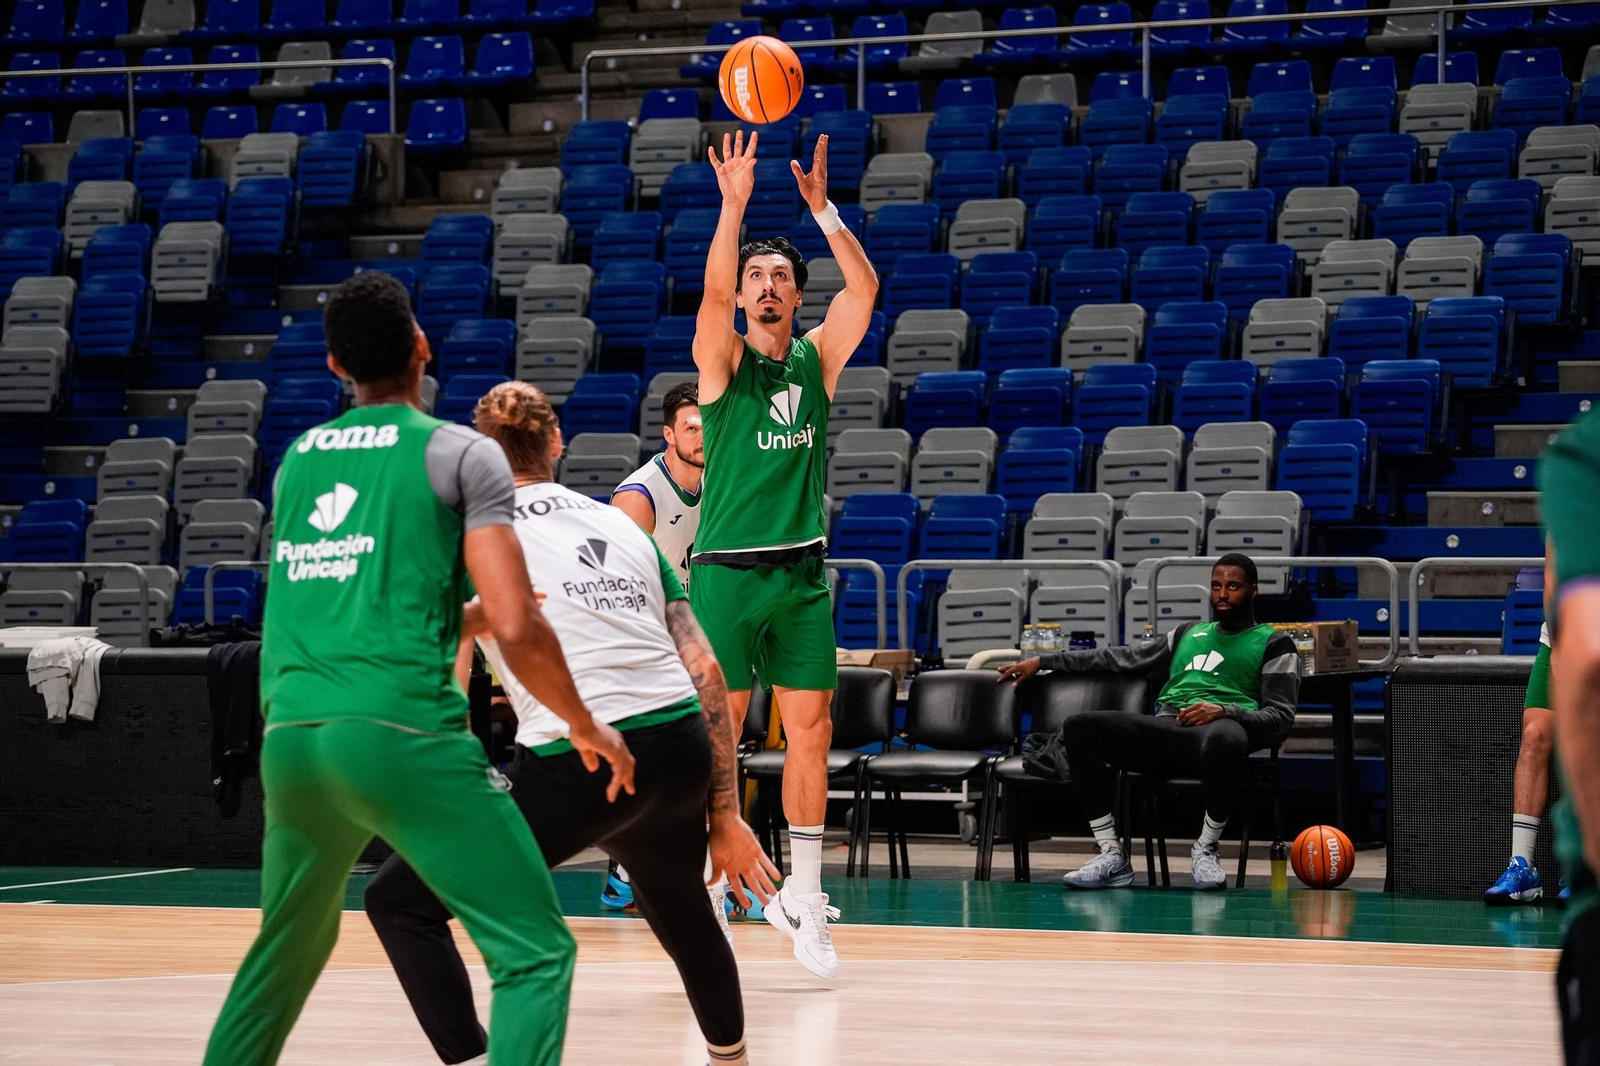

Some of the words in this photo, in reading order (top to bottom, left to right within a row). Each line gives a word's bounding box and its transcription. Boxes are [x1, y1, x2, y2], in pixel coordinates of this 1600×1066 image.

[757, 423, 816, 450] Unicaj
[276, 533, 375, 563] Fundación
[287, 556, 358, 583] Unicaja
[563, 576, 648, 597] Fundación
[585, 592, 646, 612] Unicaja
[1326, 837, 1341, 881] Wilson
